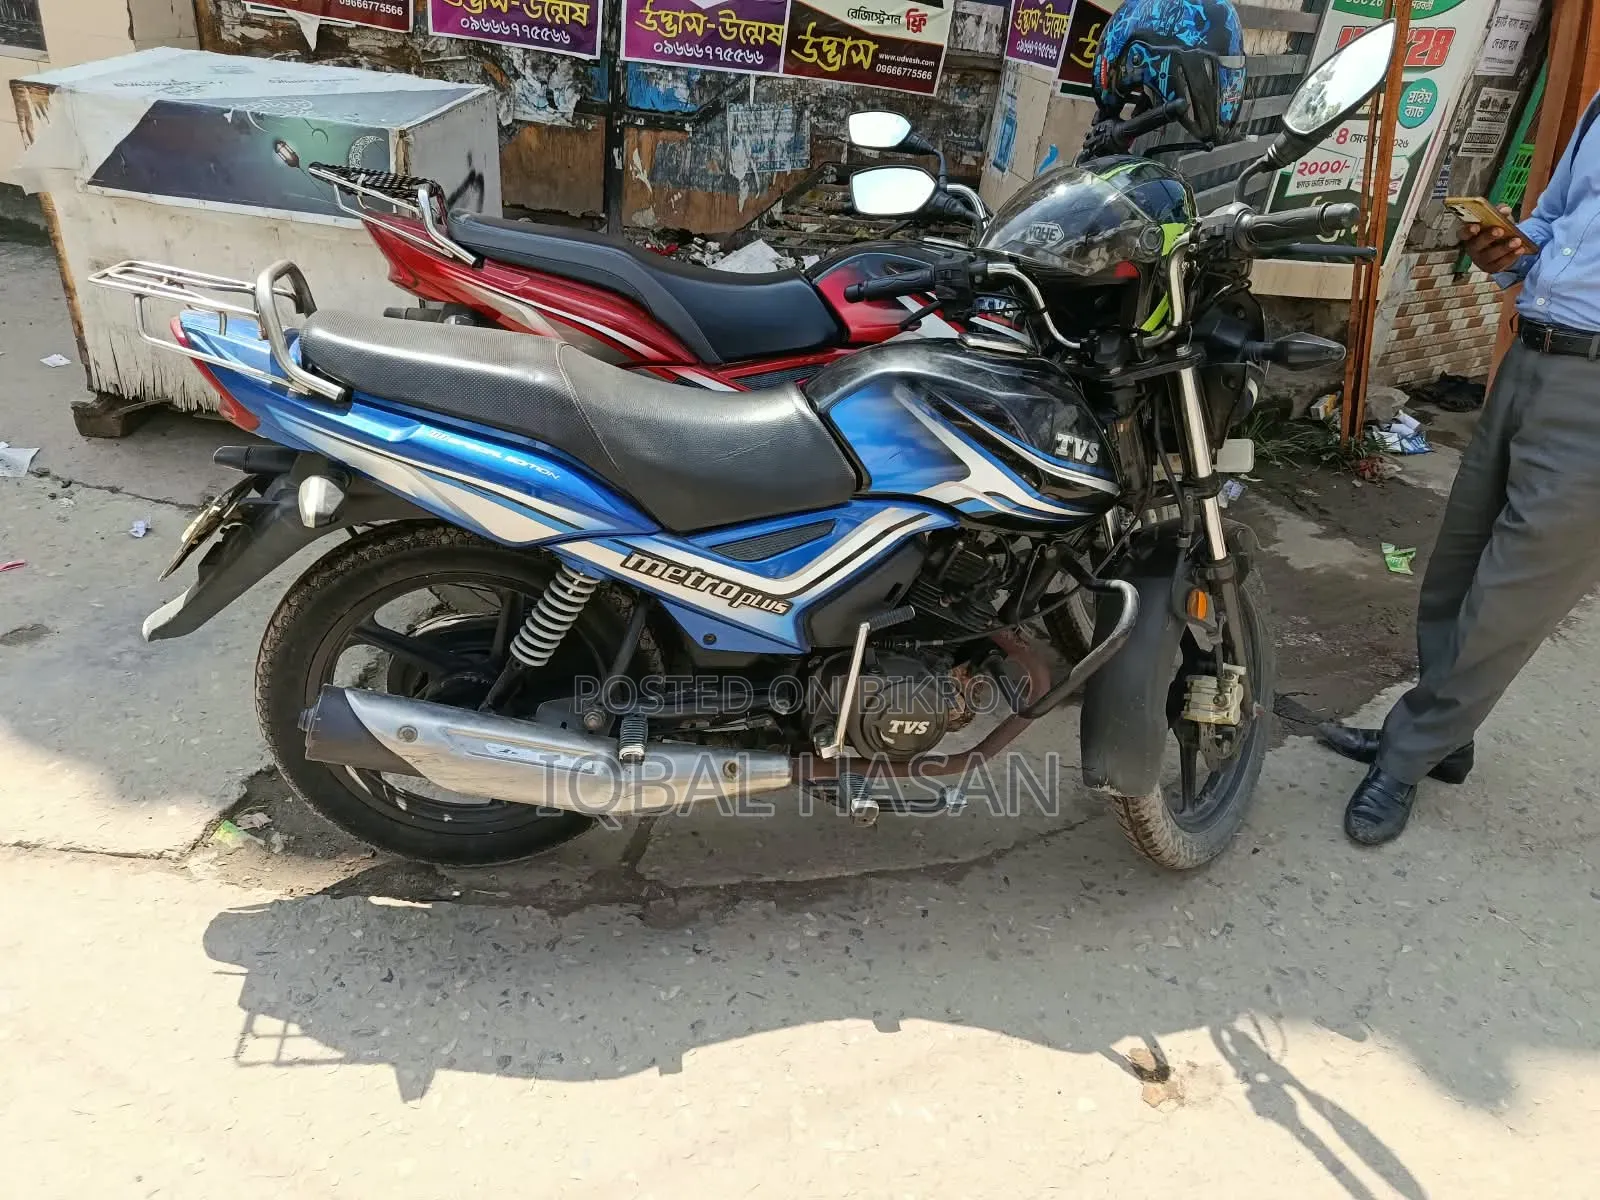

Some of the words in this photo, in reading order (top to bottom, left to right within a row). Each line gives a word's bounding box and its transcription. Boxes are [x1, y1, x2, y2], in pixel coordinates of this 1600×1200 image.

[460, 16, 571, 44] ০৯৬৬৬৭৭৫৫৬৬
[906, 8, 928, 33] ফ্রি
[654, 40, 764, 64] ০৯৬৬৬৭৭৫৫৬৬
[791, 22, 879, 72] উদ্ভাস
[876, 64, 932, 80] 09666775566
[879, 53, 935, 67] www.udvash.com
[1054, 433, 1100, 463] TVS
[623, 552, 742, 599] metro
[888, 720, 930, 735] TVS
